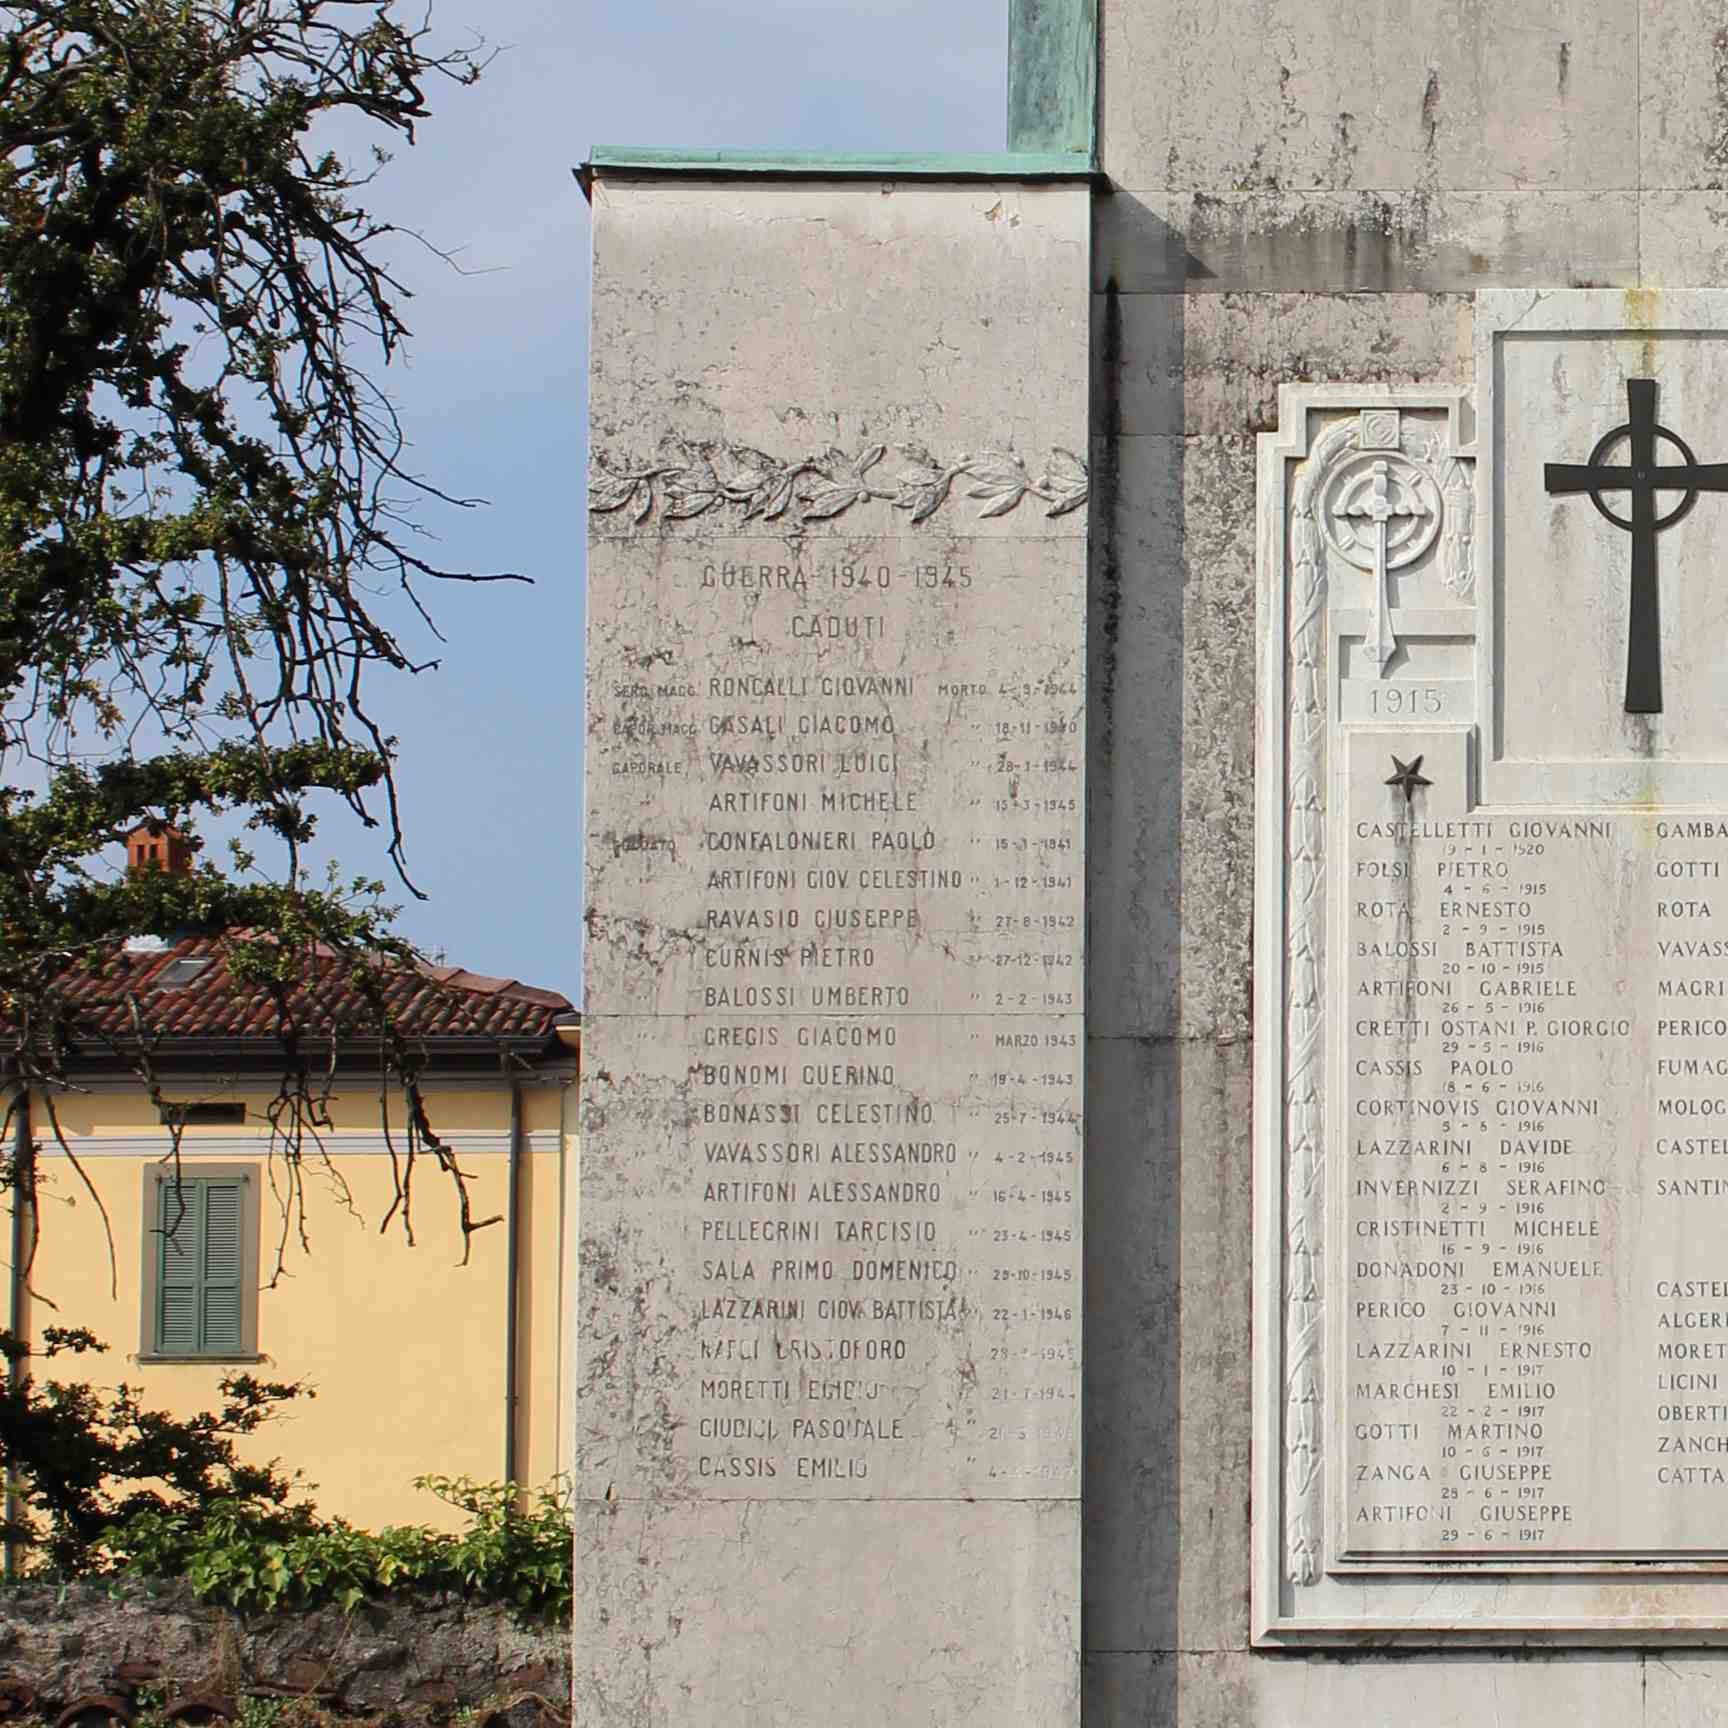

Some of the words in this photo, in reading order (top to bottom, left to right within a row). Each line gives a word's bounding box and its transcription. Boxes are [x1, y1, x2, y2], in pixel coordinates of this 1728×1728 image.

[702, 564, 808, 590] GUERRA
[791, 615, 885, 639] CADUTI
[708, 677, 808, 697] RONCALLI
[821, 677, 914, 697] GIOVANNI
[1369, 688, 1441, 714] 1915
[708, 792, 807, 813] ARTIFONI
[821, 792, 918, 813] MICHELE
[1508, 821, 1613, 839] GIOVANNI
[706, 831, 857, 851] CONFALONIERI
[1655, 861, 1720, 879] GOTTI
[707, 870, 796, 889] ARTIFONI
[860, 871, 962, 889] CELESTINO
[706, 908, 800, 929] RAVASIO
[814, 908, 919, 929] GIUSEPPE
[1357, 901, 1411, 918] ROTA
[1439, 901, 1532, 918] ERNESTO
[1657, 901, 1712, 918] ROTA
[1357, 941, 1438, 958] BALOSSI
[1465, 941, 1564, 958] BATTISTA
[1357, 980, 1452, 997] ARTIFONI
[1478, 980, 1578, 997] GABRIELE
[1657, 980, 1725, 997] MAGRI
[705, 987, 795, 1007] BALOSSI
[811, 987, 910, 1009] UMBERTO
[1354, 1020, 1430, 1037] CRETTI
[1440, 1020, 1516, 1037] OSTANI
[1546, 1020, 1631, 1037] GIORGIO
[1657, 1019, 1728, 1037] PERICO
[703, 1027, 779, 1047] GREGIS
[797, 1027, 897, 1047] GIACOMO
[995, 1034, 1038, 1048] MARZO
[703, 1065, 787, 1086] BONOMI
[801, 1065, 895, 1086] GUERINO
[1355, 1059, 1423, 1077] CASSIS
[1450, 1059, 1514, 1077] PAOLO
[817, 1103, 933, 1124] CELESTINO
[1355, 1099, 1481, 1117] CORTINOVIS
[1495, 1099, 1599, 1117] GIOVANNI
[704, 1142, 821, 1163] VAVASSORI
[830, 1142, 957, 1163] ALESSANDRO
[1357, 1139, 1472, 1157] LAZZARINI
[1499, 1139, 1574, 1157] DAVIDE
[703, 1182, 797, 1203] ARTIFONI
[807, 1182, 941, 1203] ALESSANDRO
[1356, 1179, 1479, 1197] INVERNIZZI
[1505, 1179, 1607, 1197] SERAFINO
[702, 1221, 819, 1242] PELLEGRINI
[835, 1221, 937, 1242] TARCISIO
[1355, 1220, 1486, 1238] CRISTINETTI
[1513, 1219, 1601, 1238] MICHELE
[703, 1260, 755, 1281] SALA
[772, 1260, 833, 1281] PRIMO
[852, 1260, 957, 1281] DOMENICO
[1356, 1261, 1465, 1279] DONADONI
[1492, 1261, 1602, 1278] EMANUELE
[1355, 1301, 1426, 1319] PERICO
[1453, 1301, 1557, 1319] GIOVANNI
[1355, 1342, 1472, 1359] LAZZARINI
[1499, 1341, 1593, 1359] ERNESTO
[1354, 1383, 1460, 1400] MARCHESI
[1487, 1382, 1557, 1400] EMILIO
[1657, 1373, 1718, 1391] LICINI
[1657, 1404, 1728, 1422] OBERTI
[1354, 1423, 1419, 1441] GOTTI
[1446, 1422, 1543, 1440] MARTINO
[699, 1457, 777, 1479] CASSIS
[1459, 1463, 1553, 1481] GIUSEPPE
[1479, 1504, 1573, 1522] GIUSEPPE
